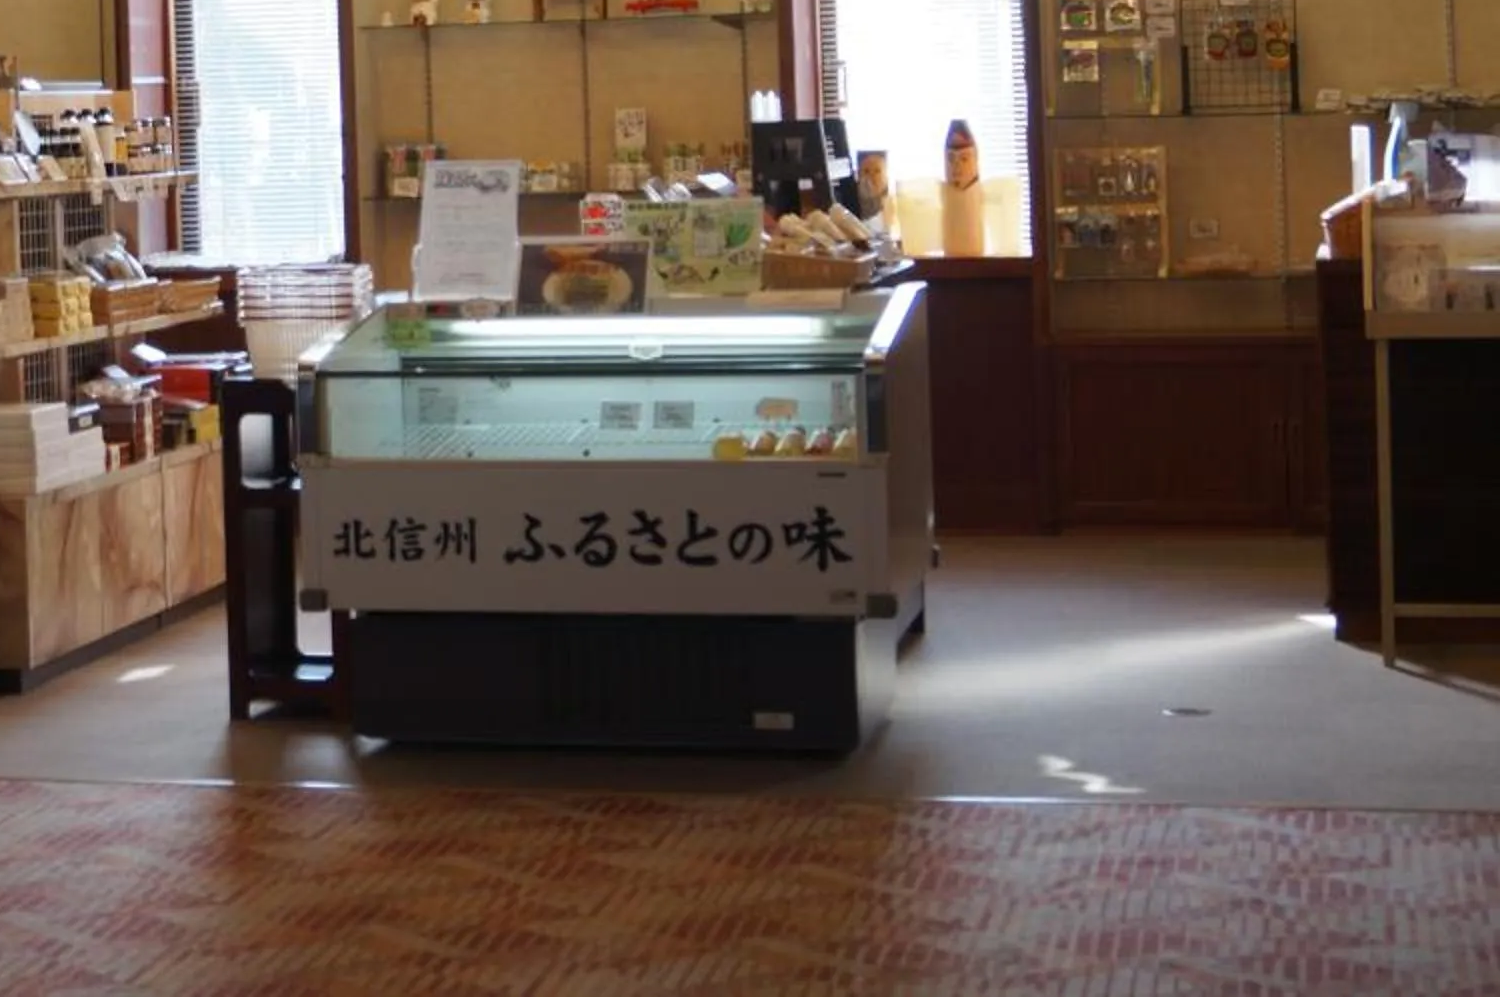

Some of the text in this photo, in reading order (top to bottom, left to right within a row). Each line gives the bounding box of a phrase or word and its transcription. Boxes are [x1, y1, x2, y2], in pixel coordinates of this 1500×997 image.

[333, 505, 853, 572] 北信州 ふるさとの味
